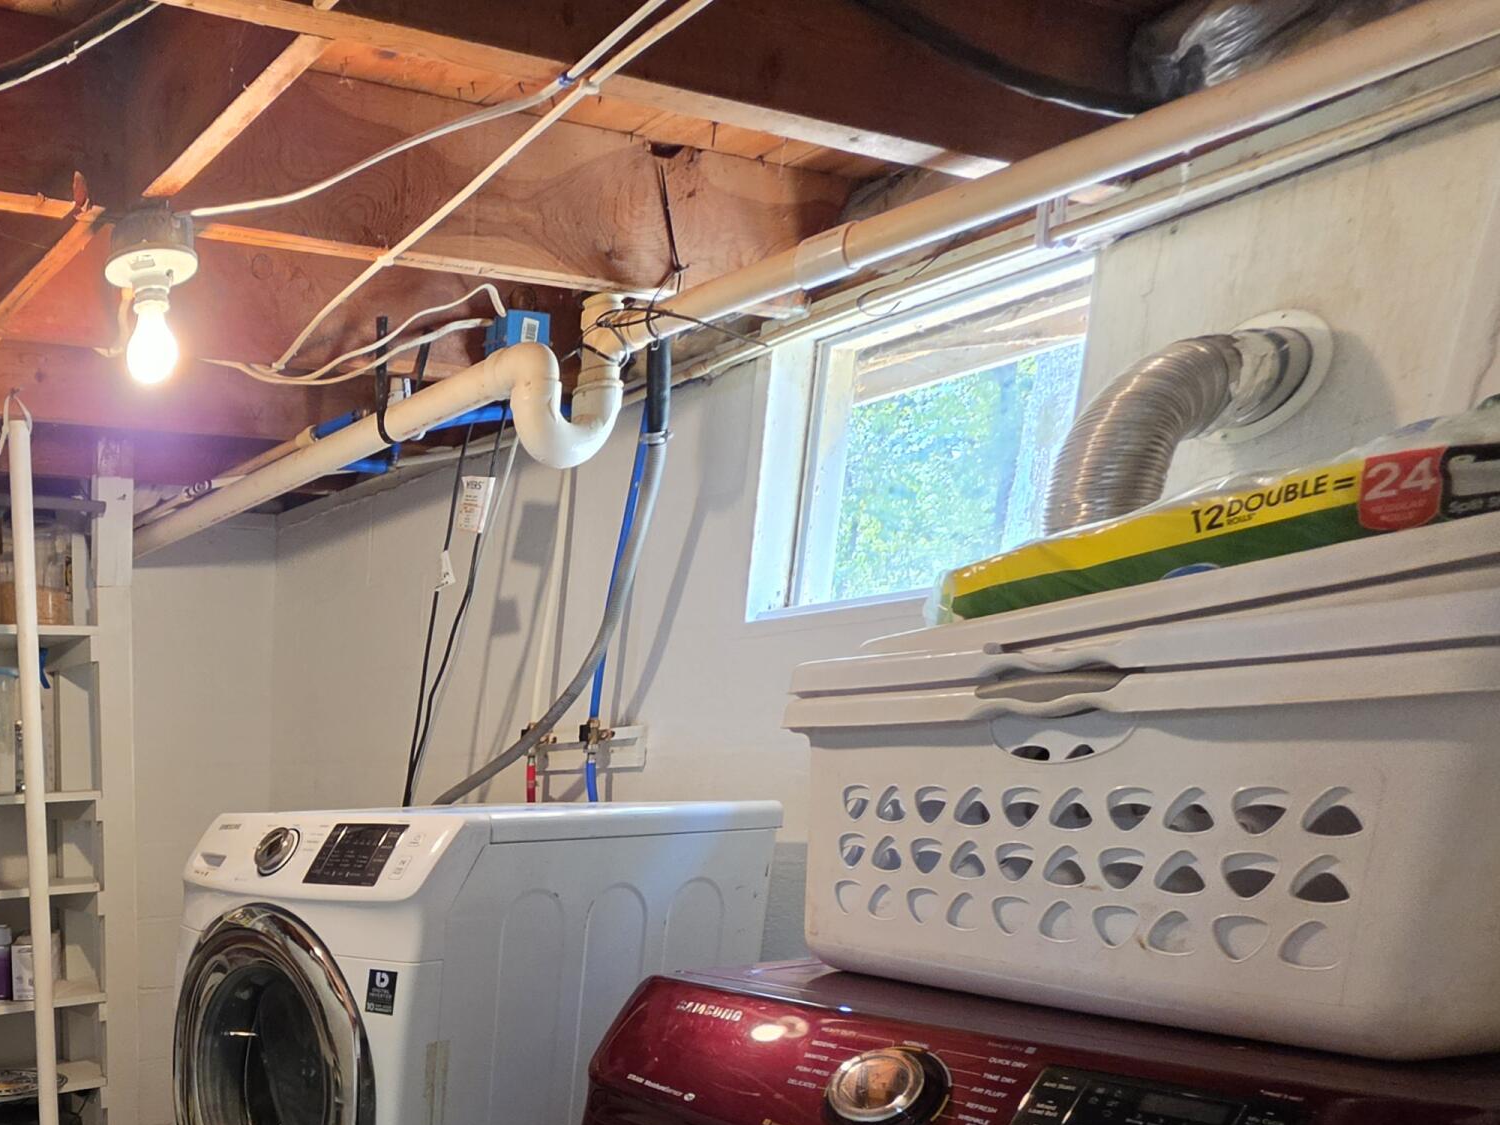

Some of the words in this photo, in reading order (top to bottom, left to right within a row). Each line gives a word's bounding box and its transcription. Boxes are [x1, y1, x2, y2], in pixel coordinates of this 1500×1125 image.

[1191, 504, 1227, 533] 12
[1226, 474, 1330, 518] DOUBLE
[1364, 456, 1438, 501] 24
[676, 1001, 743, 1021] SAMSUNG
[1011, 1060, 1029, 1069] DRY
[982, 1072, 1000, 1081] TIME
